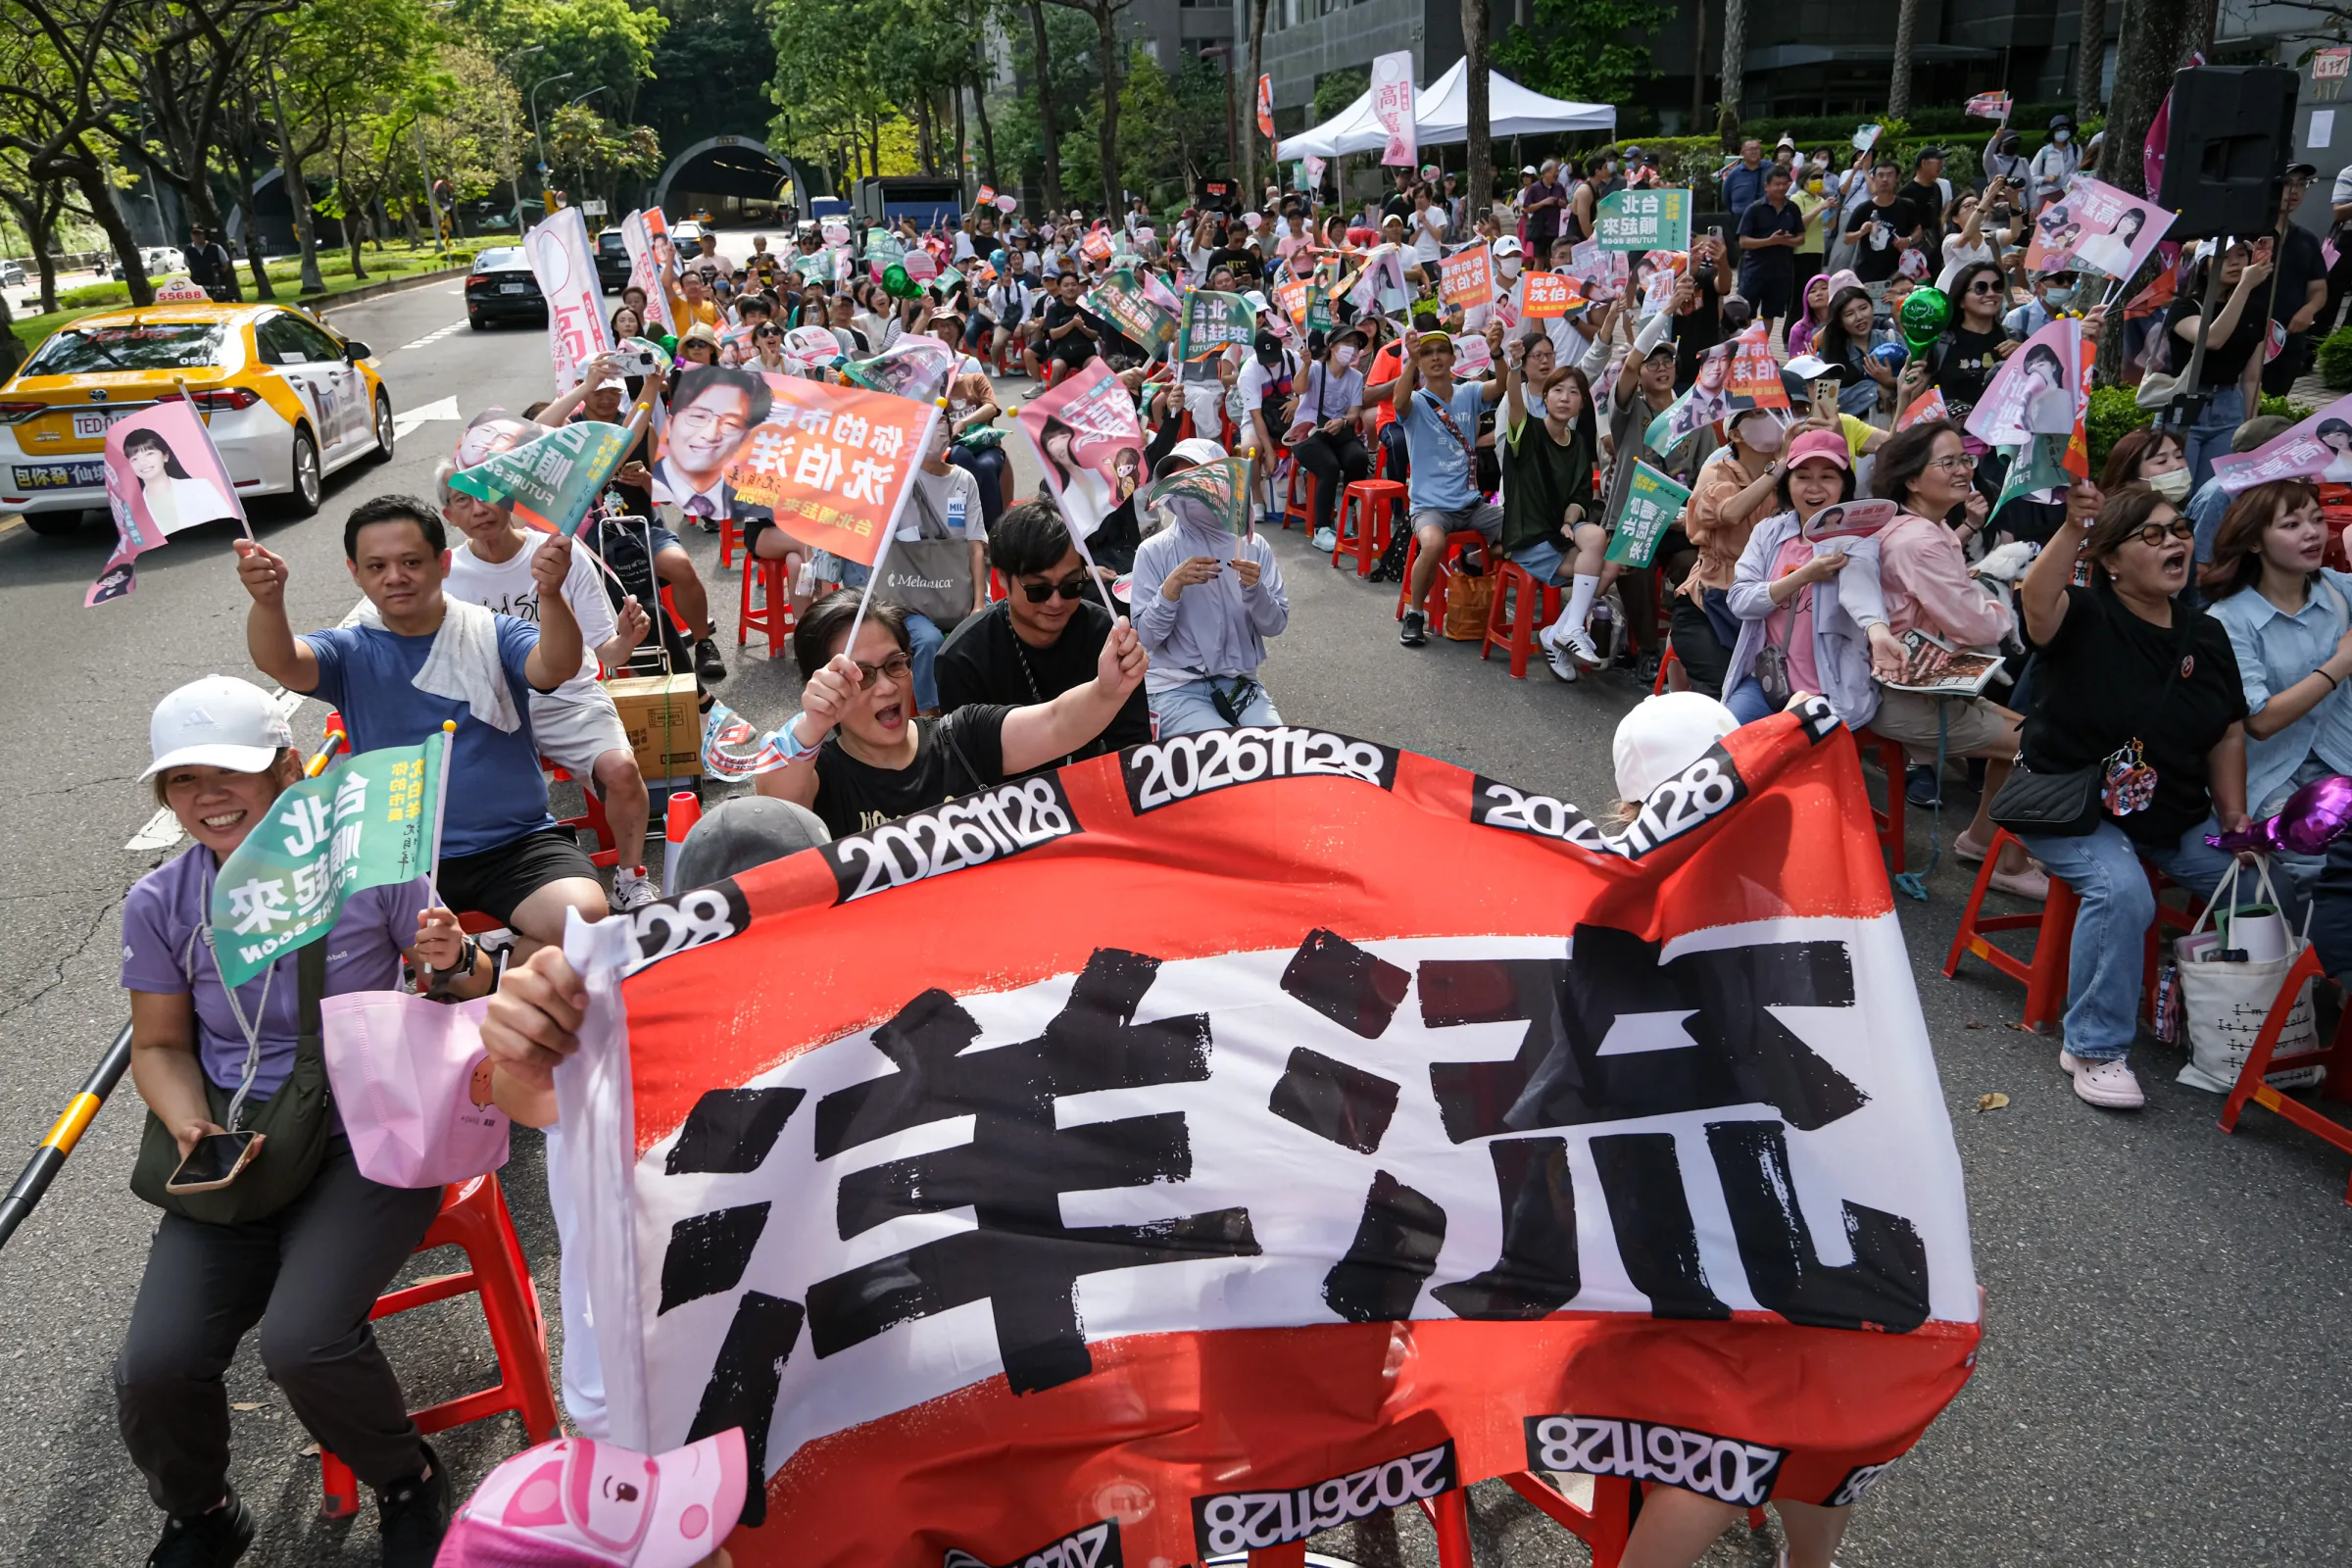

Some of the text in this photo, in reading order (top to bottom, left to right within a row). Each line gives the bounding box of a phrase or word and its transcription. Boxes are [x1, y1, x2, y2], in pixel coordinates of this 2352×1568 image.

[2318, 60, 2342, 74] 417
[1532, 276, 1564, 288] 你的
[159, 290, 202, 301] 55688
[1191, 299, 1227, 320] 台北
[1190, 321, 1250, 343] 順起來
[15, 466, 69, 487] 包你發
[1131, 726, 1385, 810] 20261128
[837, 777, 1072, 903] 20261128
[660, 928, 1932, 1527] 洋流
[1536, 1416, 1781, 1506] 20261128
[1203, 1446, 1447, 1555] 20261128
